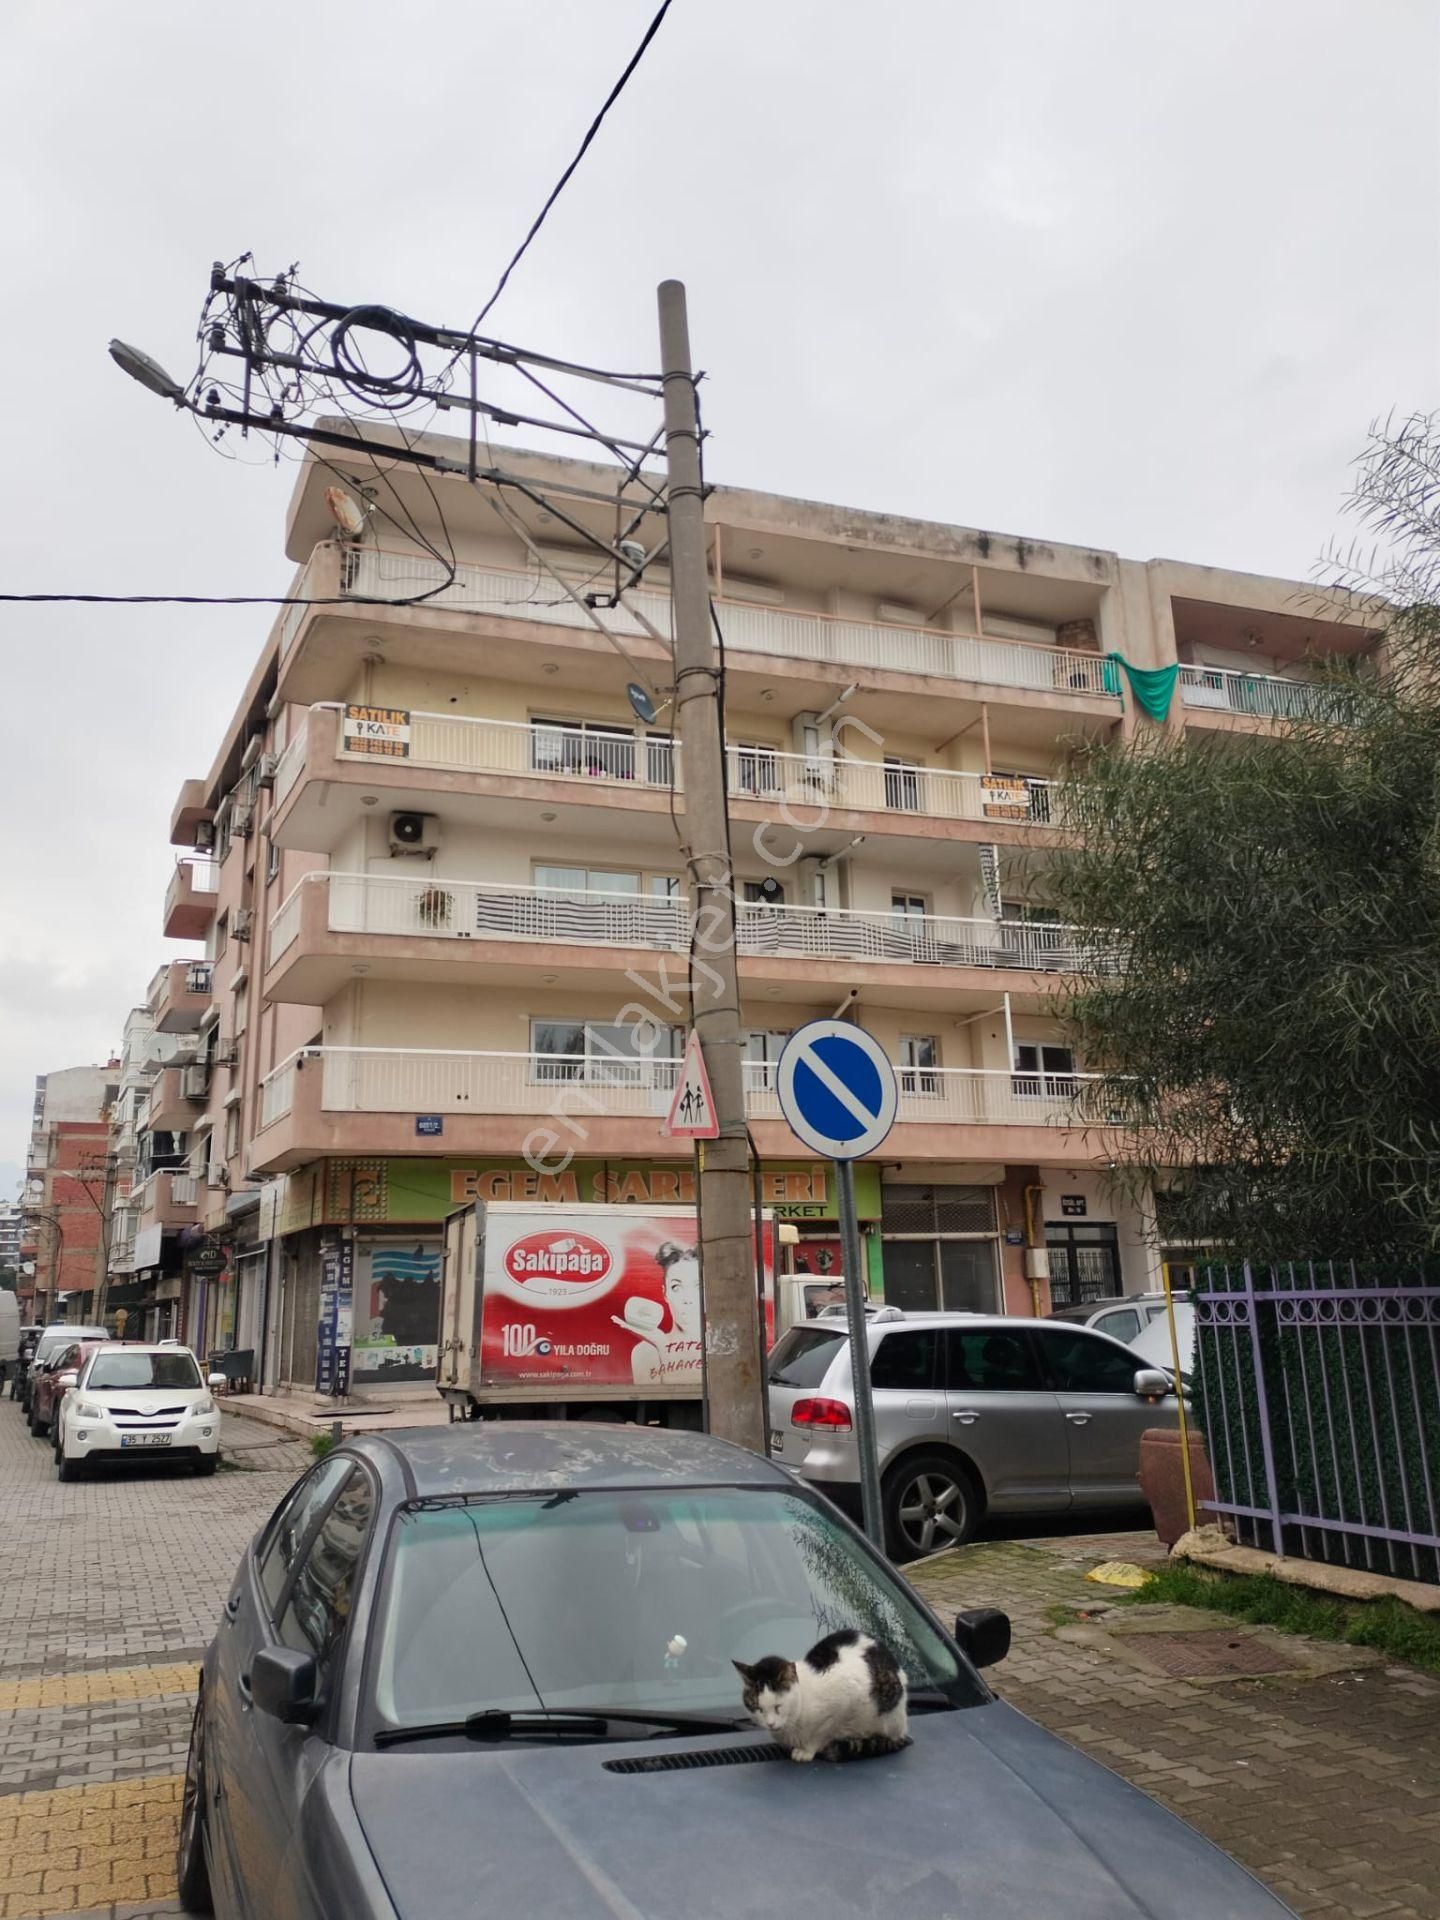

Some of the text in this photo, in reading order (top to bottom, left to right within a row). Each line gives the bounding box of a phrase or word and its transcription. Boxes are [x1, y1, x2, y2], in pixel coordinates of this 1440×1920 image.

[349, 706, 406, 725] SATILIK
[450, 1169, 580, 1203] EGEM
[549, 1288, 568, 1296] 1923
[553, 1344, 575, 1356] YILA
[576, 1342, 610, 1356] DOĞRU
